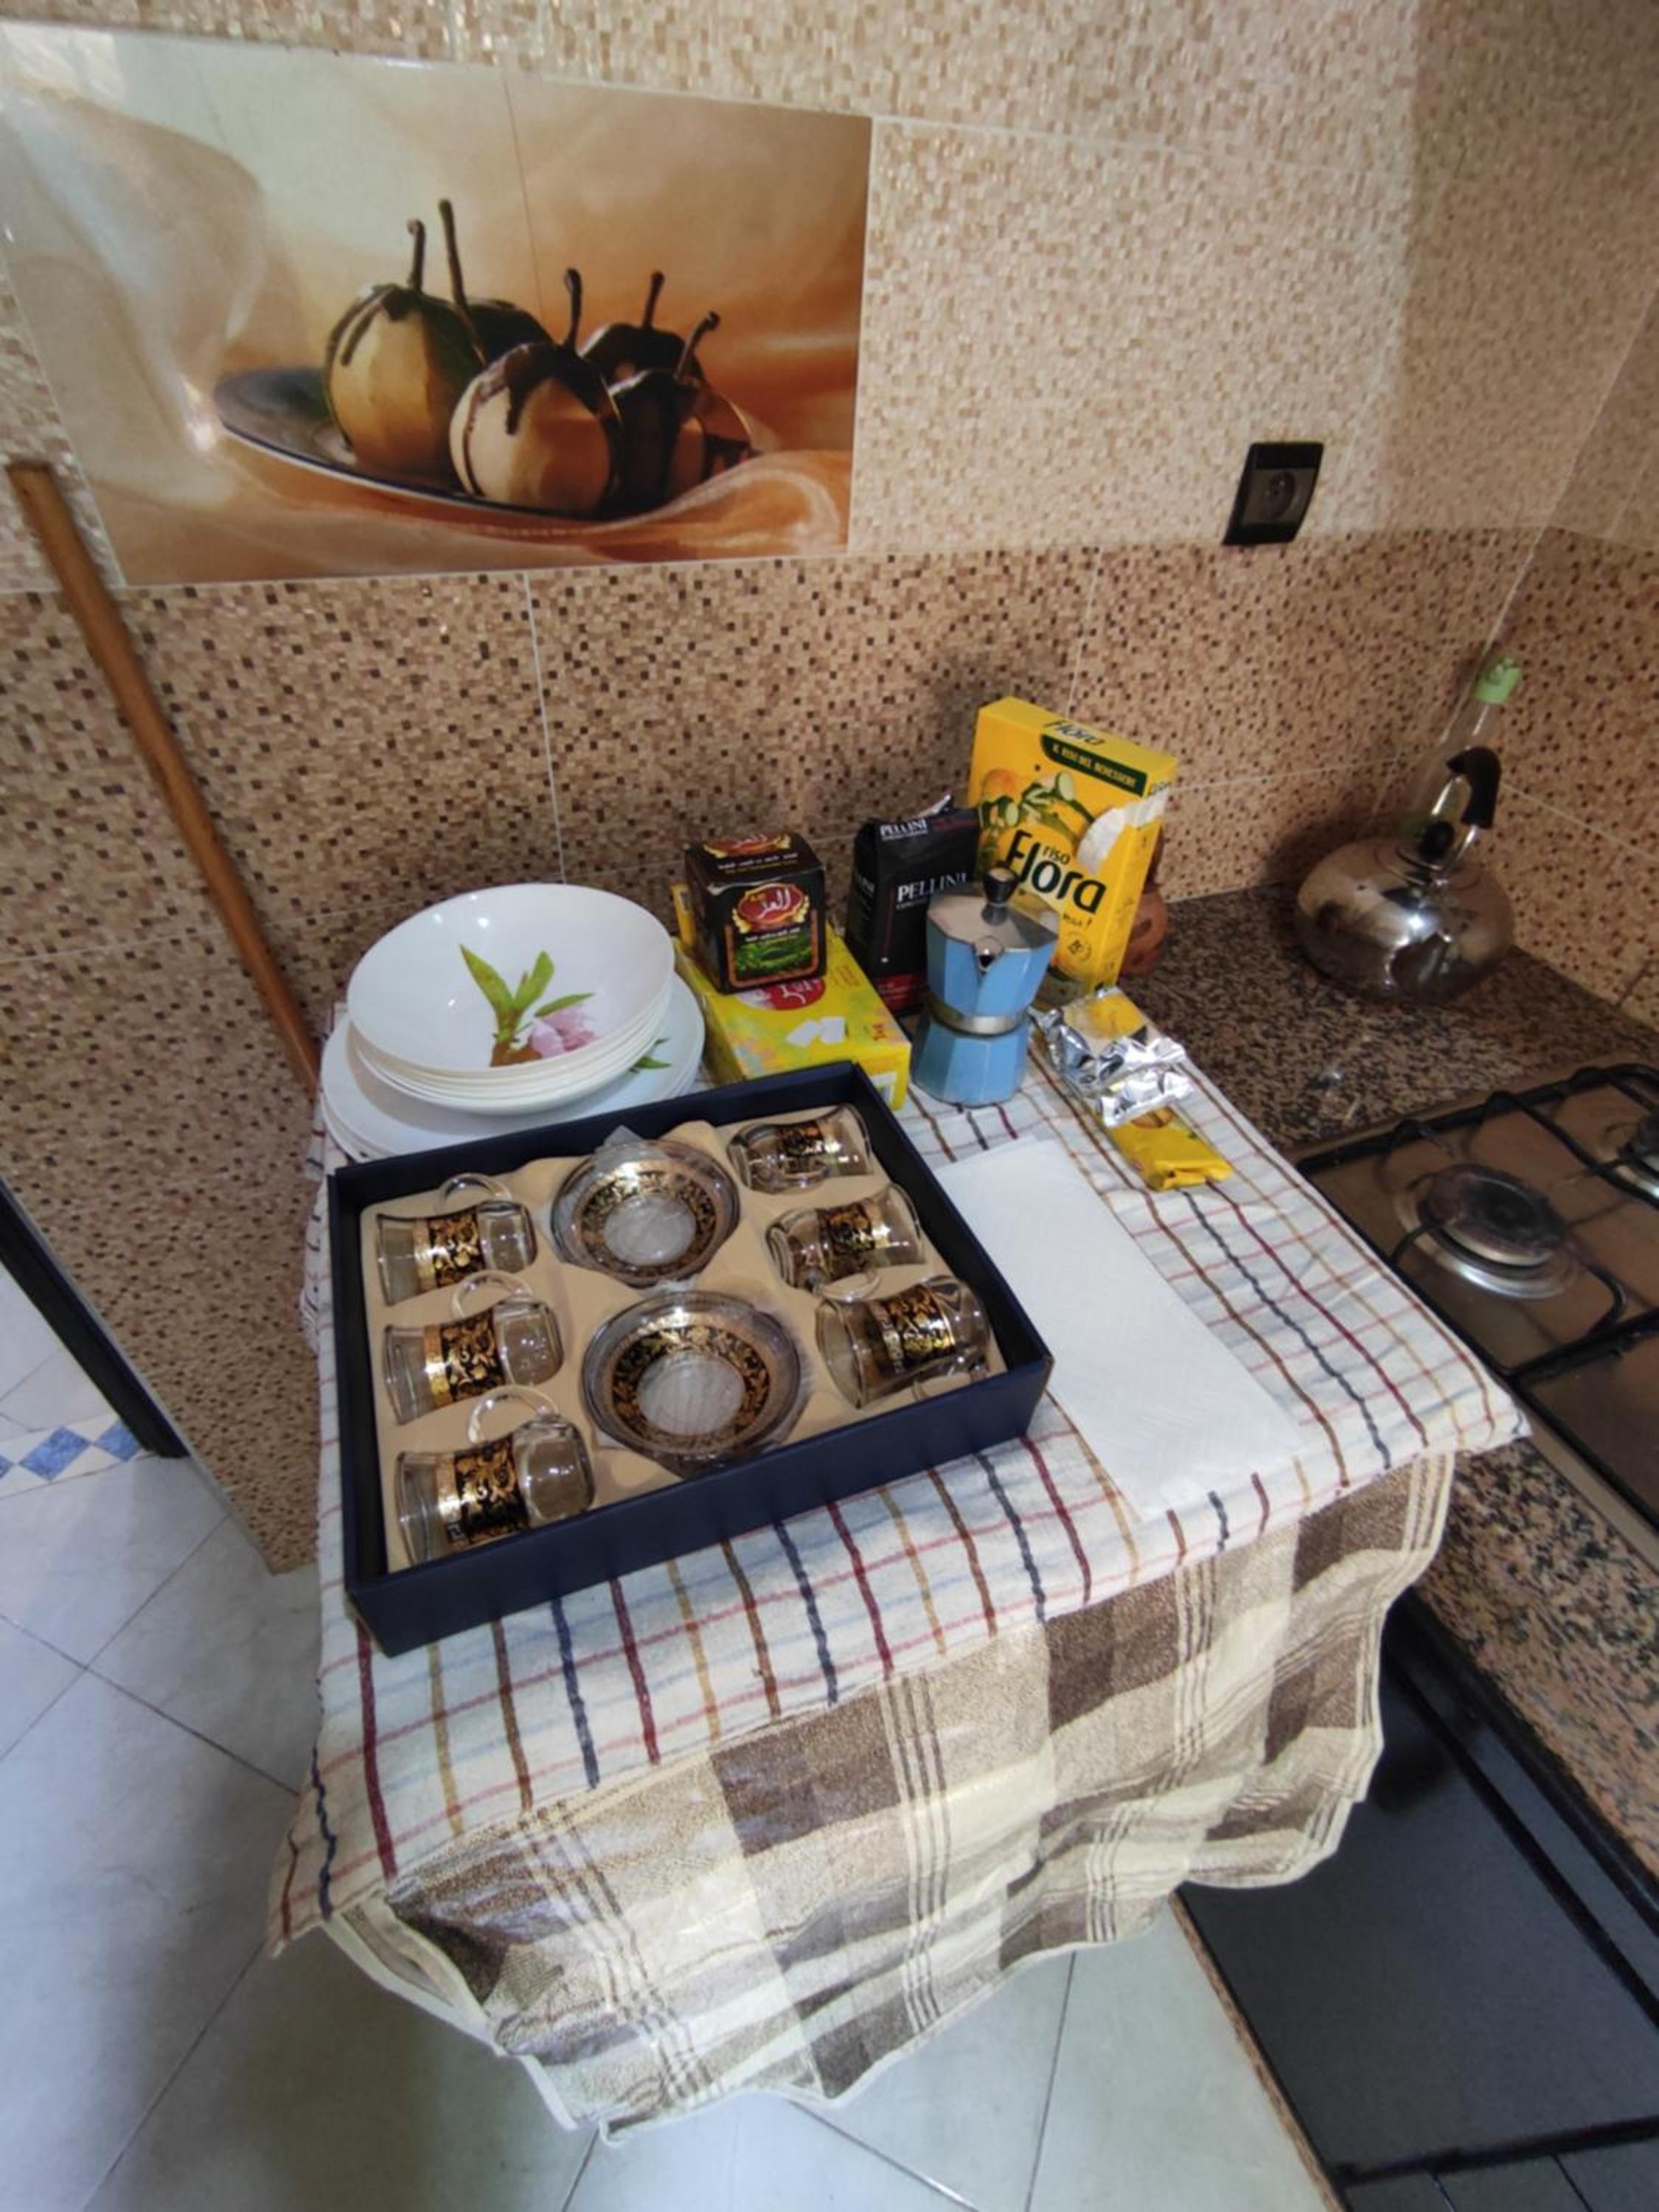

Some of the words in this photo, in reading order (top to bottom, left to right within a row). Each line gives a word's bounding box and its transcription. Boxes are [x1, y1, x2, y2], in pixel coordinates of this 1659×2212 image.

[880, 818, 928, 836] PELLINI
[1041, 846, 1071, 866] riso
[1006, 829, 1107, 915] Flora
[897, 872, 967, 902] PELLINI
